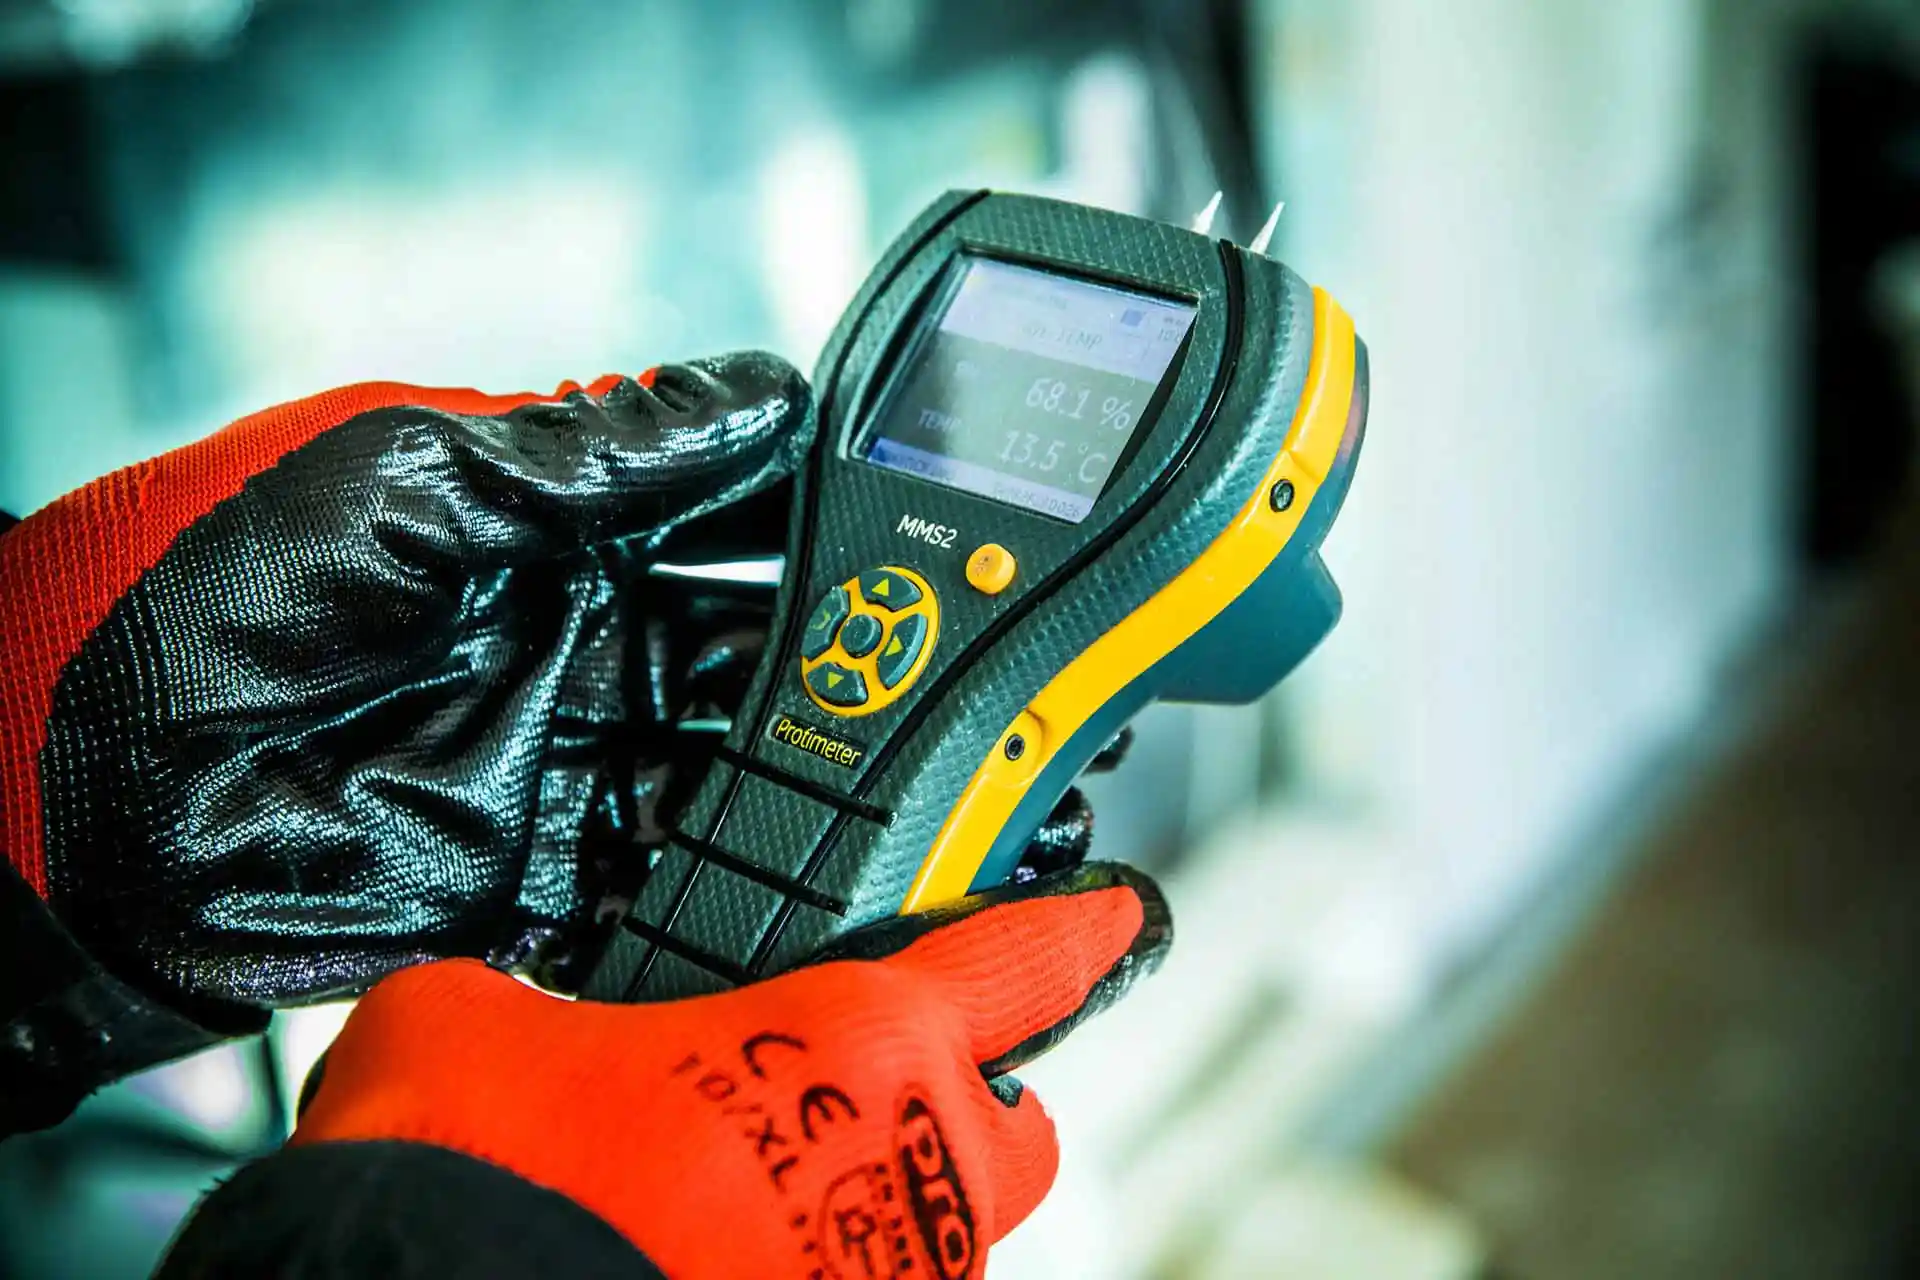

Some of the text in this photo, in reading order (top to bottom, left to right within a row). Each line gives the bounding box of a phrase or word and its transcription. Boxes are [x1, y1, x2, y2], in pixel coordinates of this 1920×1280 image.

[1025, 377, 1133, 430] 68.1 %
[999, 429, 1066, 471] 13.5
[896, 514, 958, 549] MMS2
[775, 718, 862, 767] Protimeter
